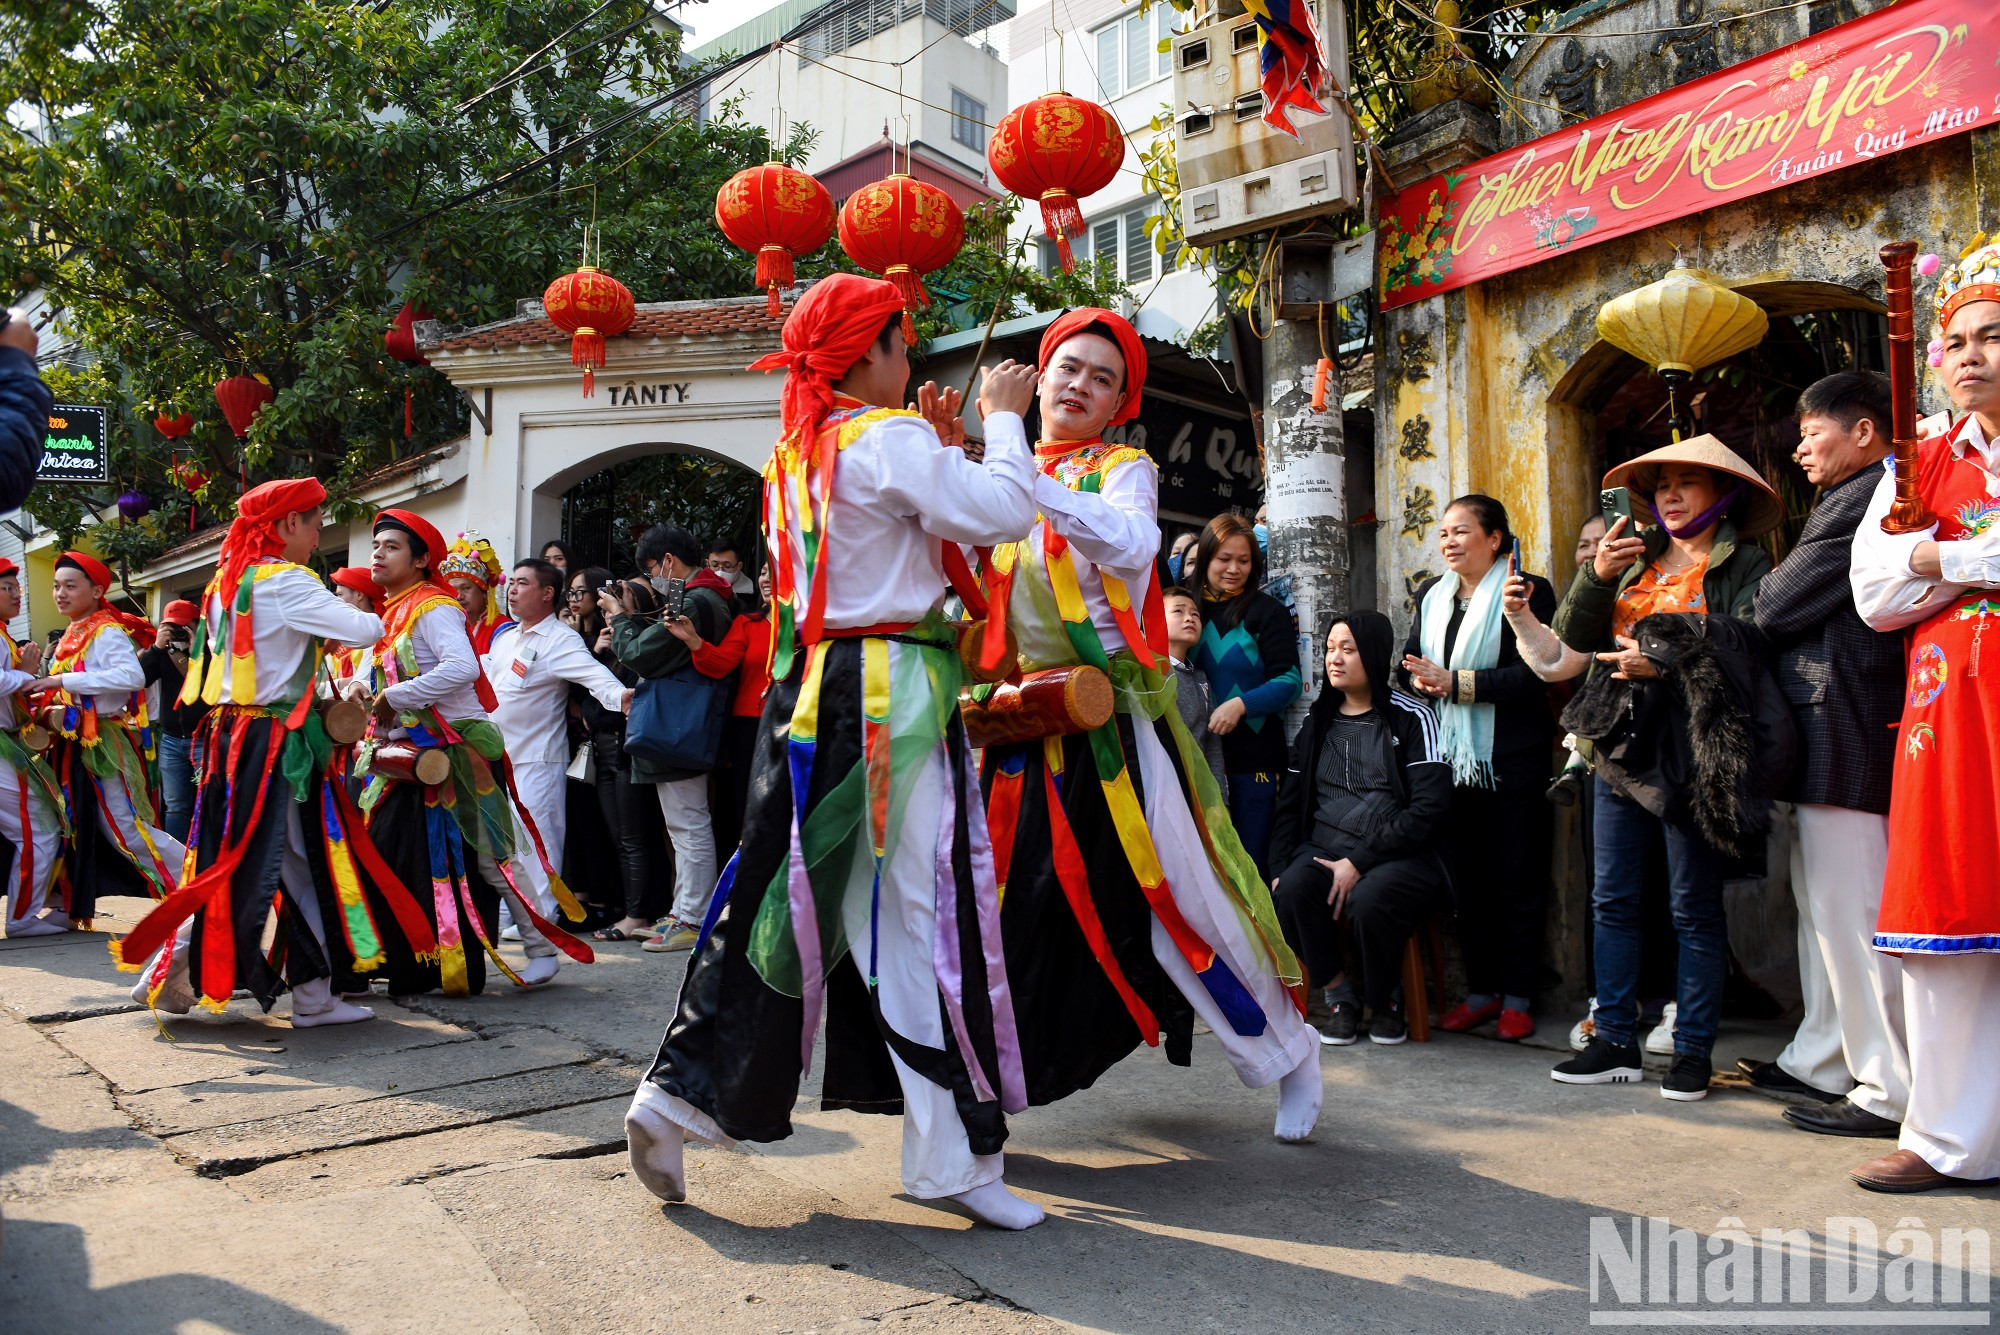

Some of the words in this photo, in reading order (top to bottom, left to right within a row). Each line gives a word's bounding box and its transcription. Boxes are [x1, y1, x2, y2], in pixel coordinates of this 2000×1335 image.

[1770, 149, 1844, 184] Xuân
[1853, 124, 1909, 158] Quý
[1915, 105, 1982, 139] Mão
[1452, 148, 1564, 256] Chúc
